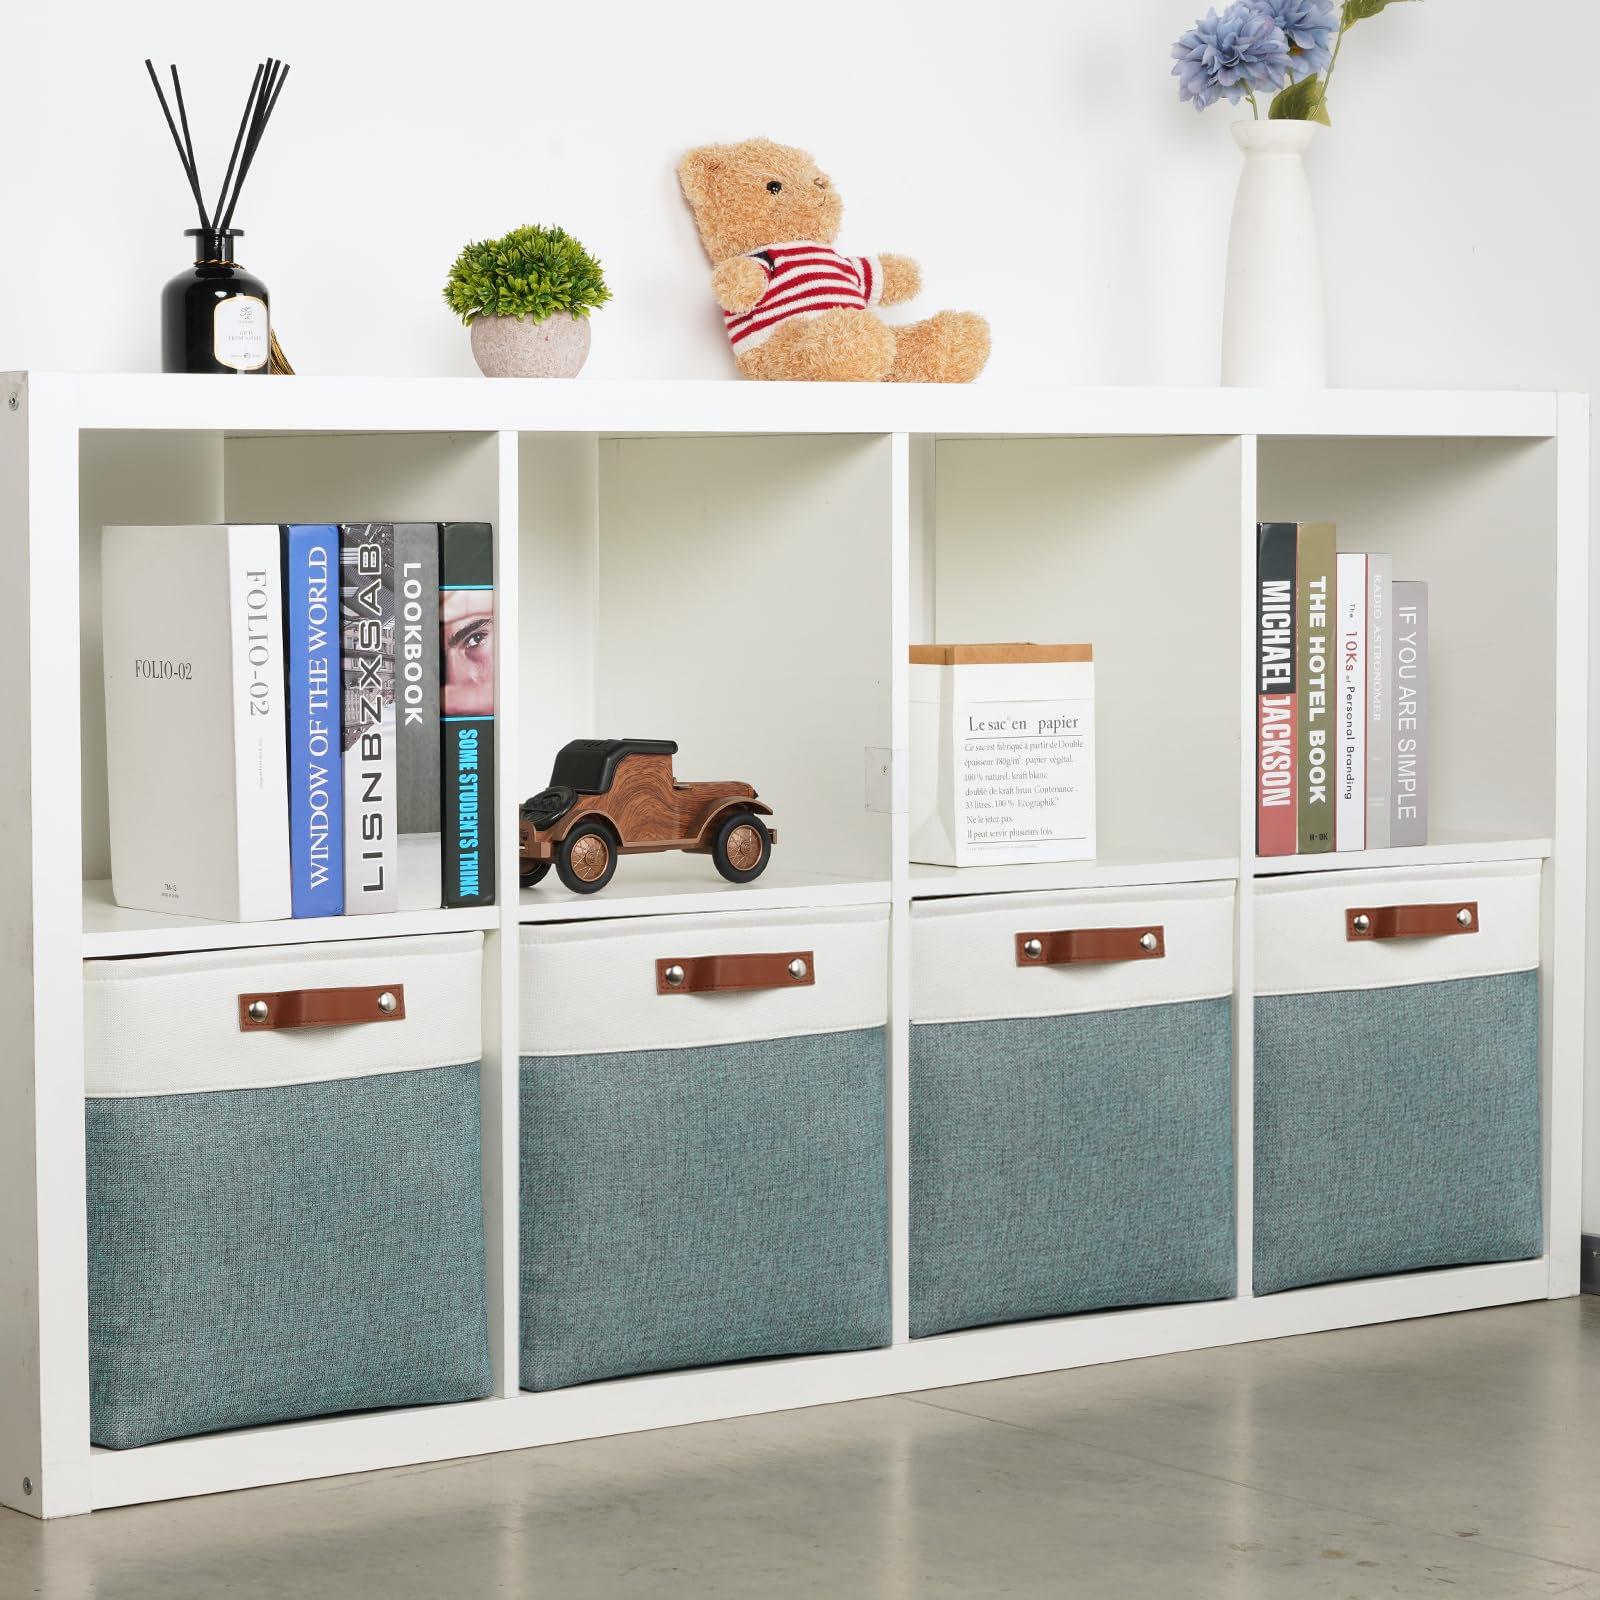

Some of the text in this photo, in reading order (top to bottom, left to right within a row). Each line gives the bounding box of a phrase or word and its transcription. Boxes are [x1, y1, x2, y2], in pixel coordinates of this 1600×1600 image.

[1373, 575, 1383, 619] RADIO
[135, 659, 193, 680] FOLIO-02
[246, 569, 270, 716] FOLIO-02
[403, 562, 423, 726] LOOKBOOK
[1345, 631, 1358, 671] 10Ks
[1261, 580, 1291, 807] MICHAEL JACKSON
[1309, 575, 1327, 805] THE HOTEL BOOK
[1345, 675, 1352, 683] of
[308, 546, 329, 890] WINDOW OF THE WORLD
[969, 715, 1078, 734] Le sac en papier
[1346, 686, 1356, 740] Personal
[1397, 607, 1417, 820] IF YOU ARE SIMPLE
[1030, 740, 1048, 751] partir
[1050, 740, 1058, 749] de
[999, 786, 1014, 795] kraft
[1012, 771, 1028, 780] kraft
[1344, 746, 1355, 800] Branding
[458, 729, 479, 897] SOME STUDENTS THINK
